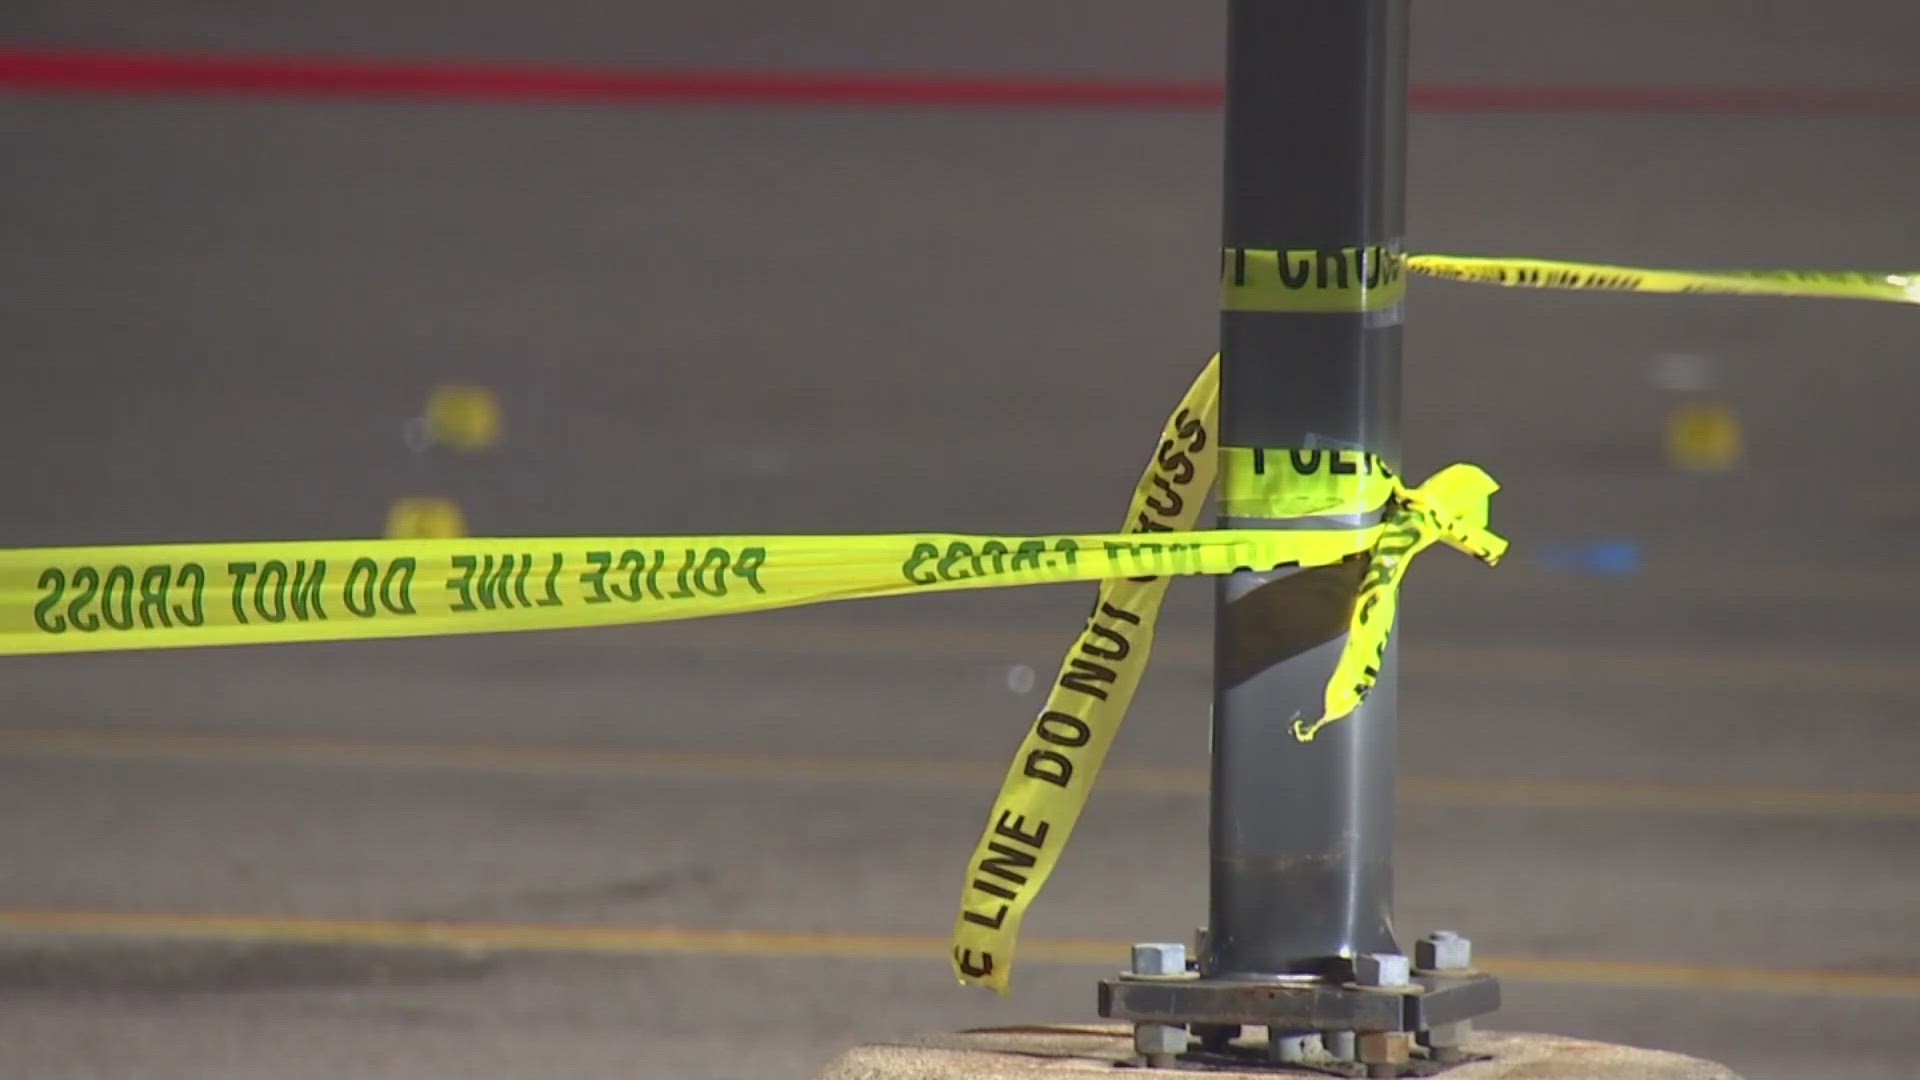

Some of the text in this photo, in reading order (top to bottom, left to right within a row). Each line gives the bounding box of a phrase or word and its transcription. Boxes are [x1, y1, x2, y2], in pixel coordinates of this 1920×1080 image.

[963, 809, 1050, 930] LINE
[1023, 710, 1091, 789] DO
[1059, 600, 1140, 701] NOT
